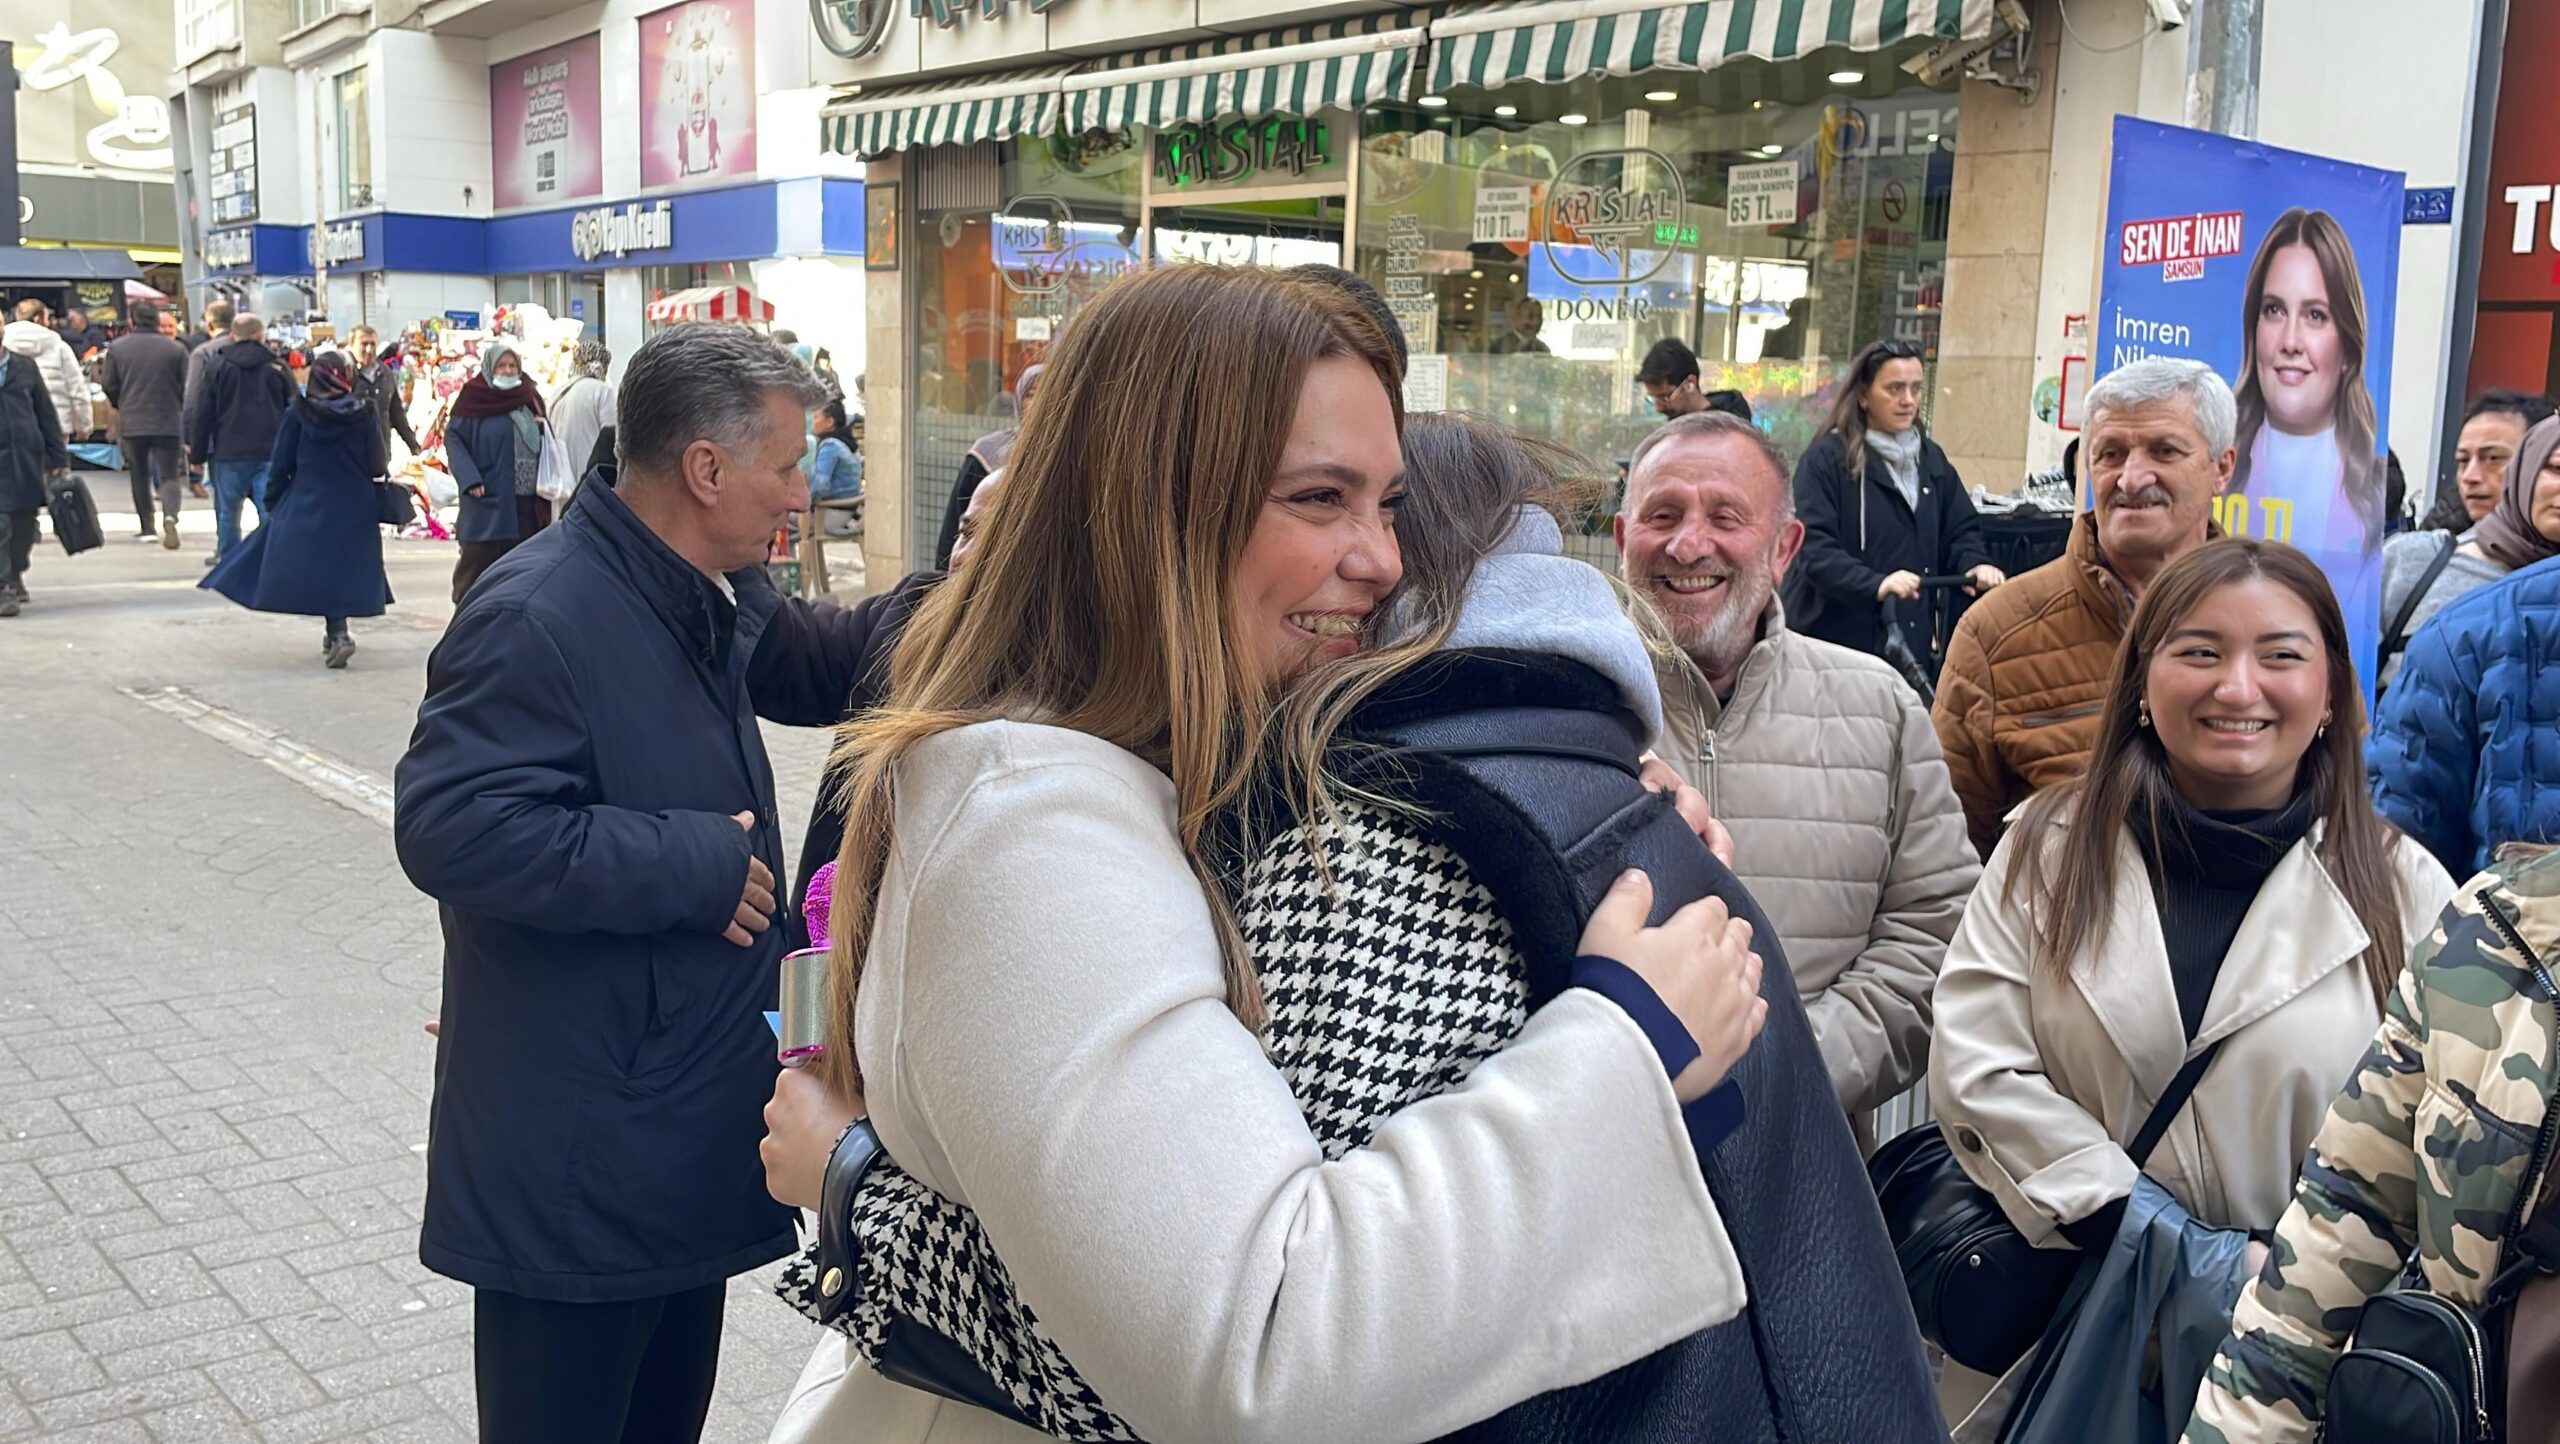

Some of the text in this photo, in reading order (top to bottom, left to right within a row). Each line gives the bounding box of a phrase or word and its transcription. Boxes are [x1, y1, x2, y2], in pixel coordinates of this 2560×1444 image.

[1730, 197, 1750, 222] 65
[1756, 195, 1773, 221] TL
[2505, 184, 2560, 254] T
[1477, 216, 1496, 238] 110
[1500, 216, 1511, 237] TL
[2123, 213, 2241, 264] SEN DE İNAN
[2165, 260, 2202, 280] SAMSUN
[1557, 291, 1649, 322] DÖNER
[2116, 306, 2190, 348] İmren
[2113, 343, 2167, 370] Nil
